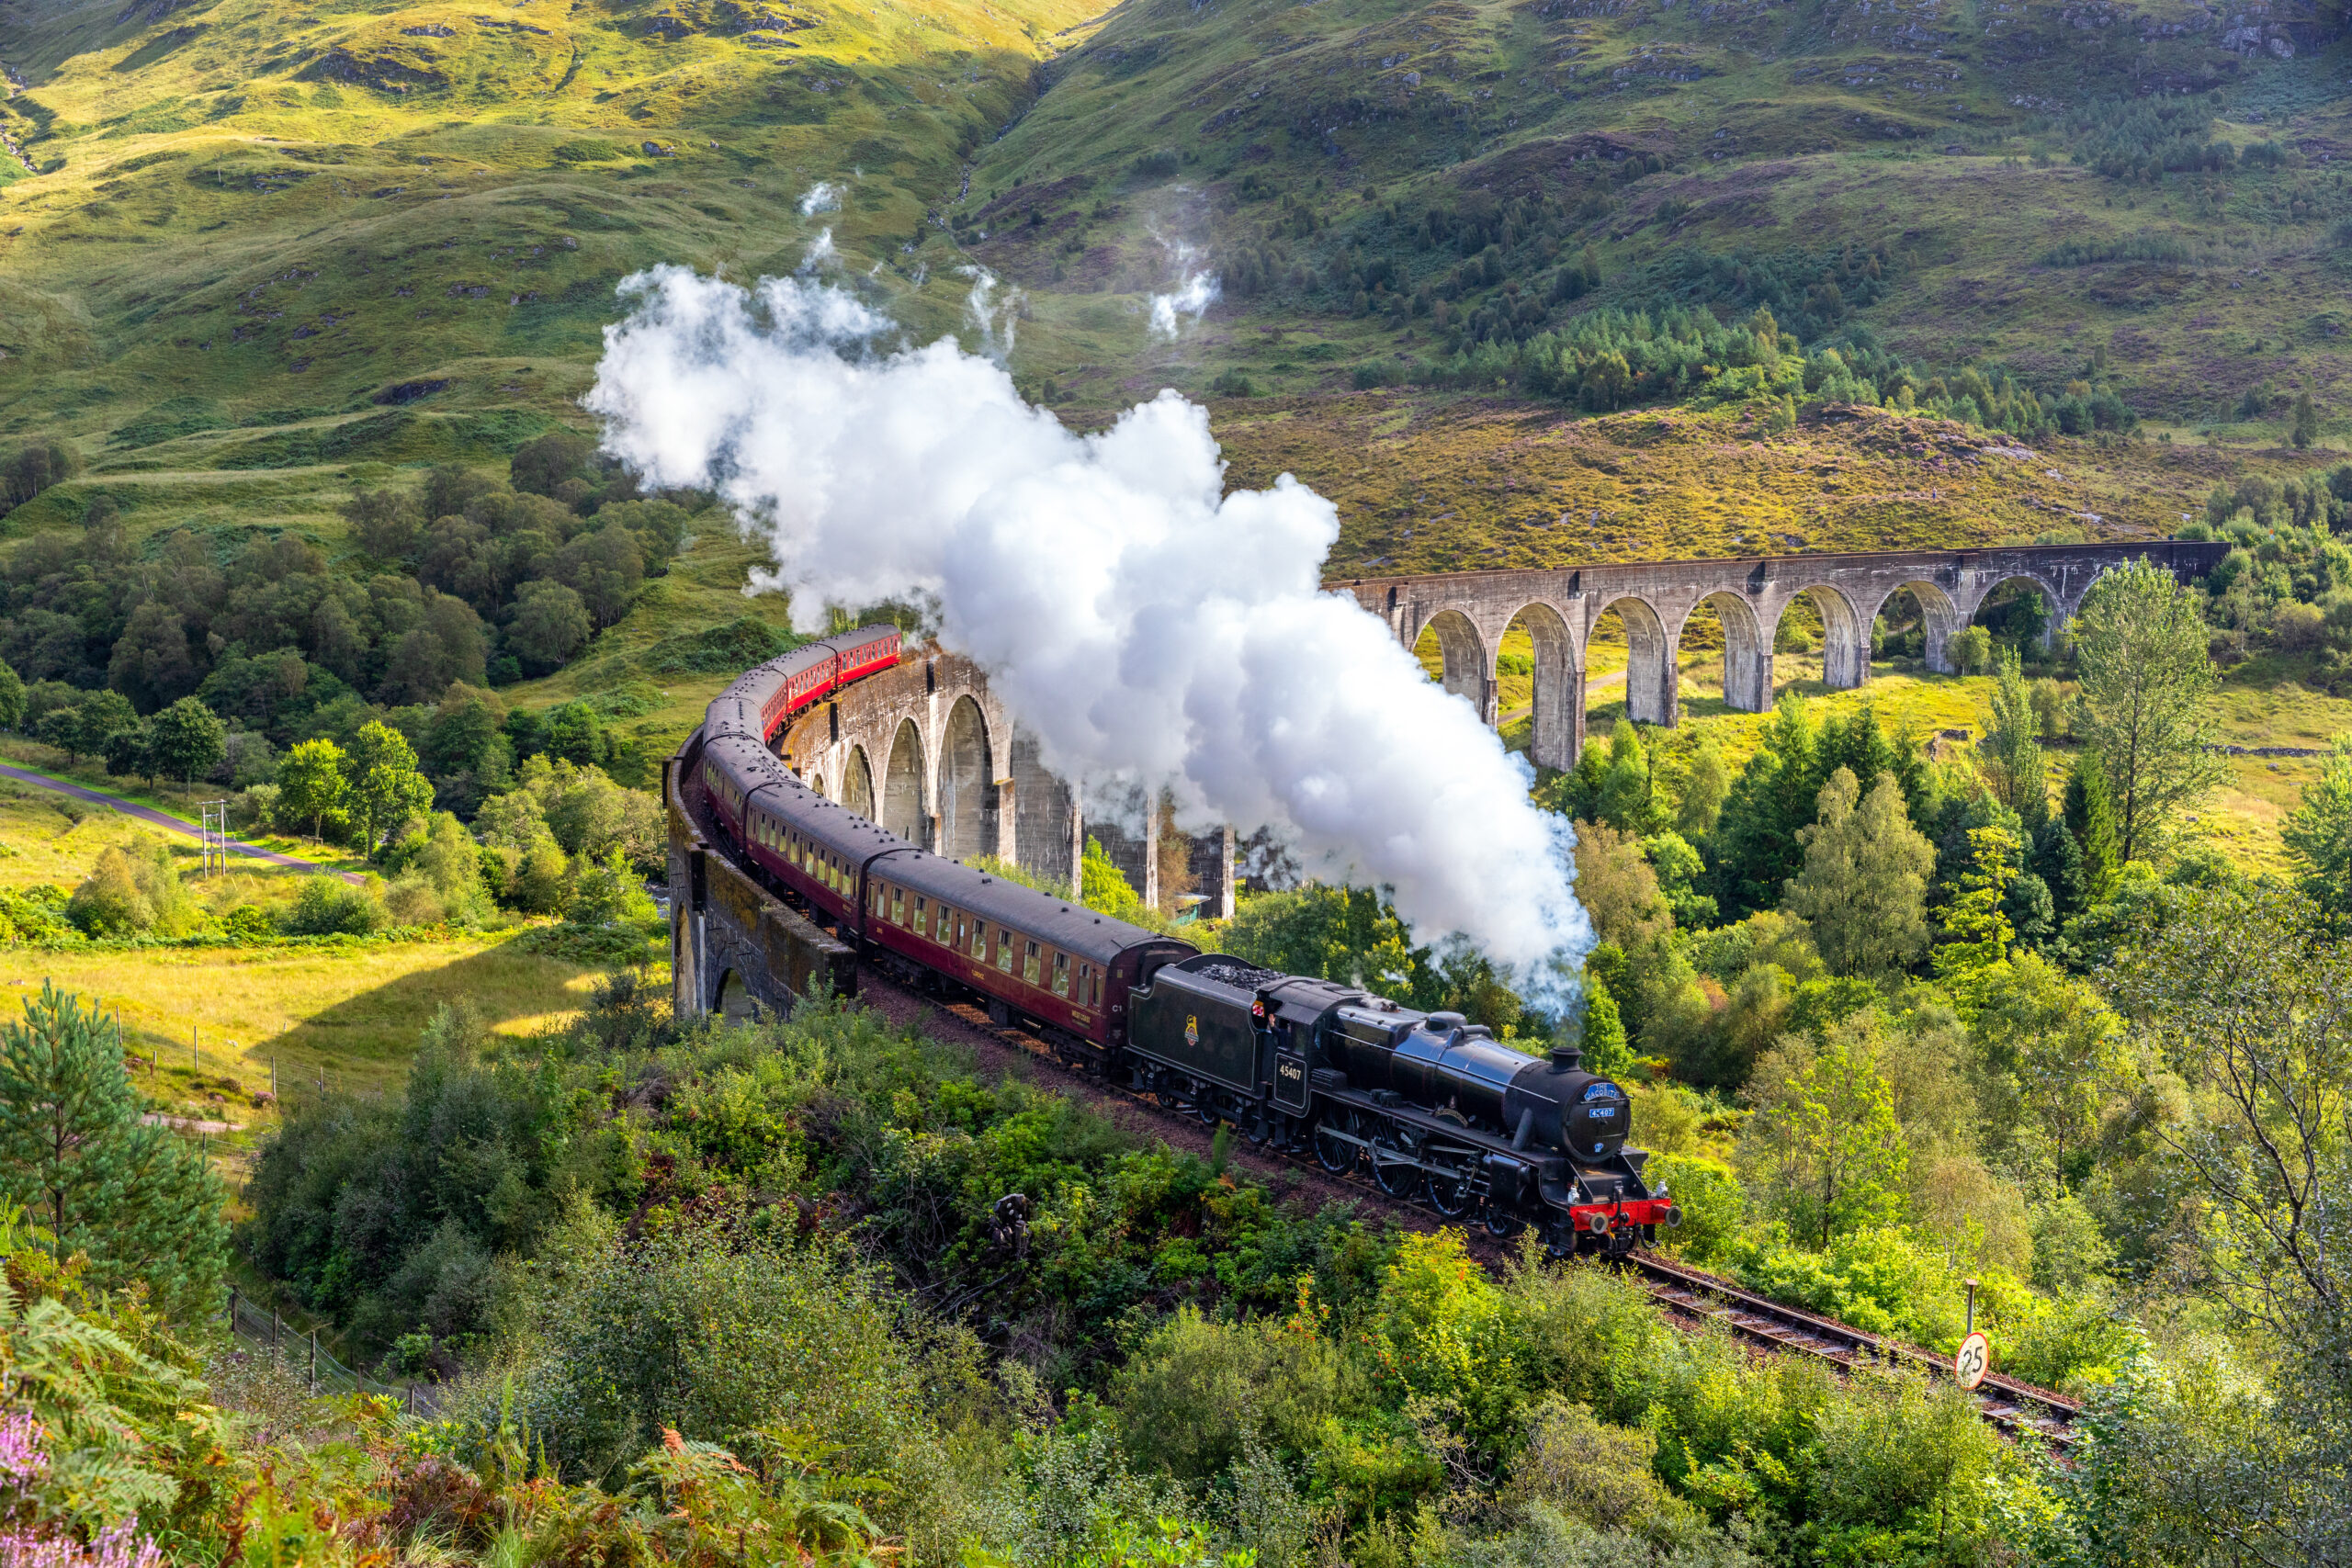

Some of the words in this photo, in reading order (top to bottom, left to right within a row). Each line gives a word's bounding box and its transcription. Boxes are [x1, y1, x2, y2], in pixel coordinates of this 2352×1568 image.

[1112, 1004, 1123, 1013] C1
[1280, 1065, 1301, 1080] 45407
[1586, 1089, 1620, 1100] JACOBITE
[1962, 1346, 1983, 1376] 25
